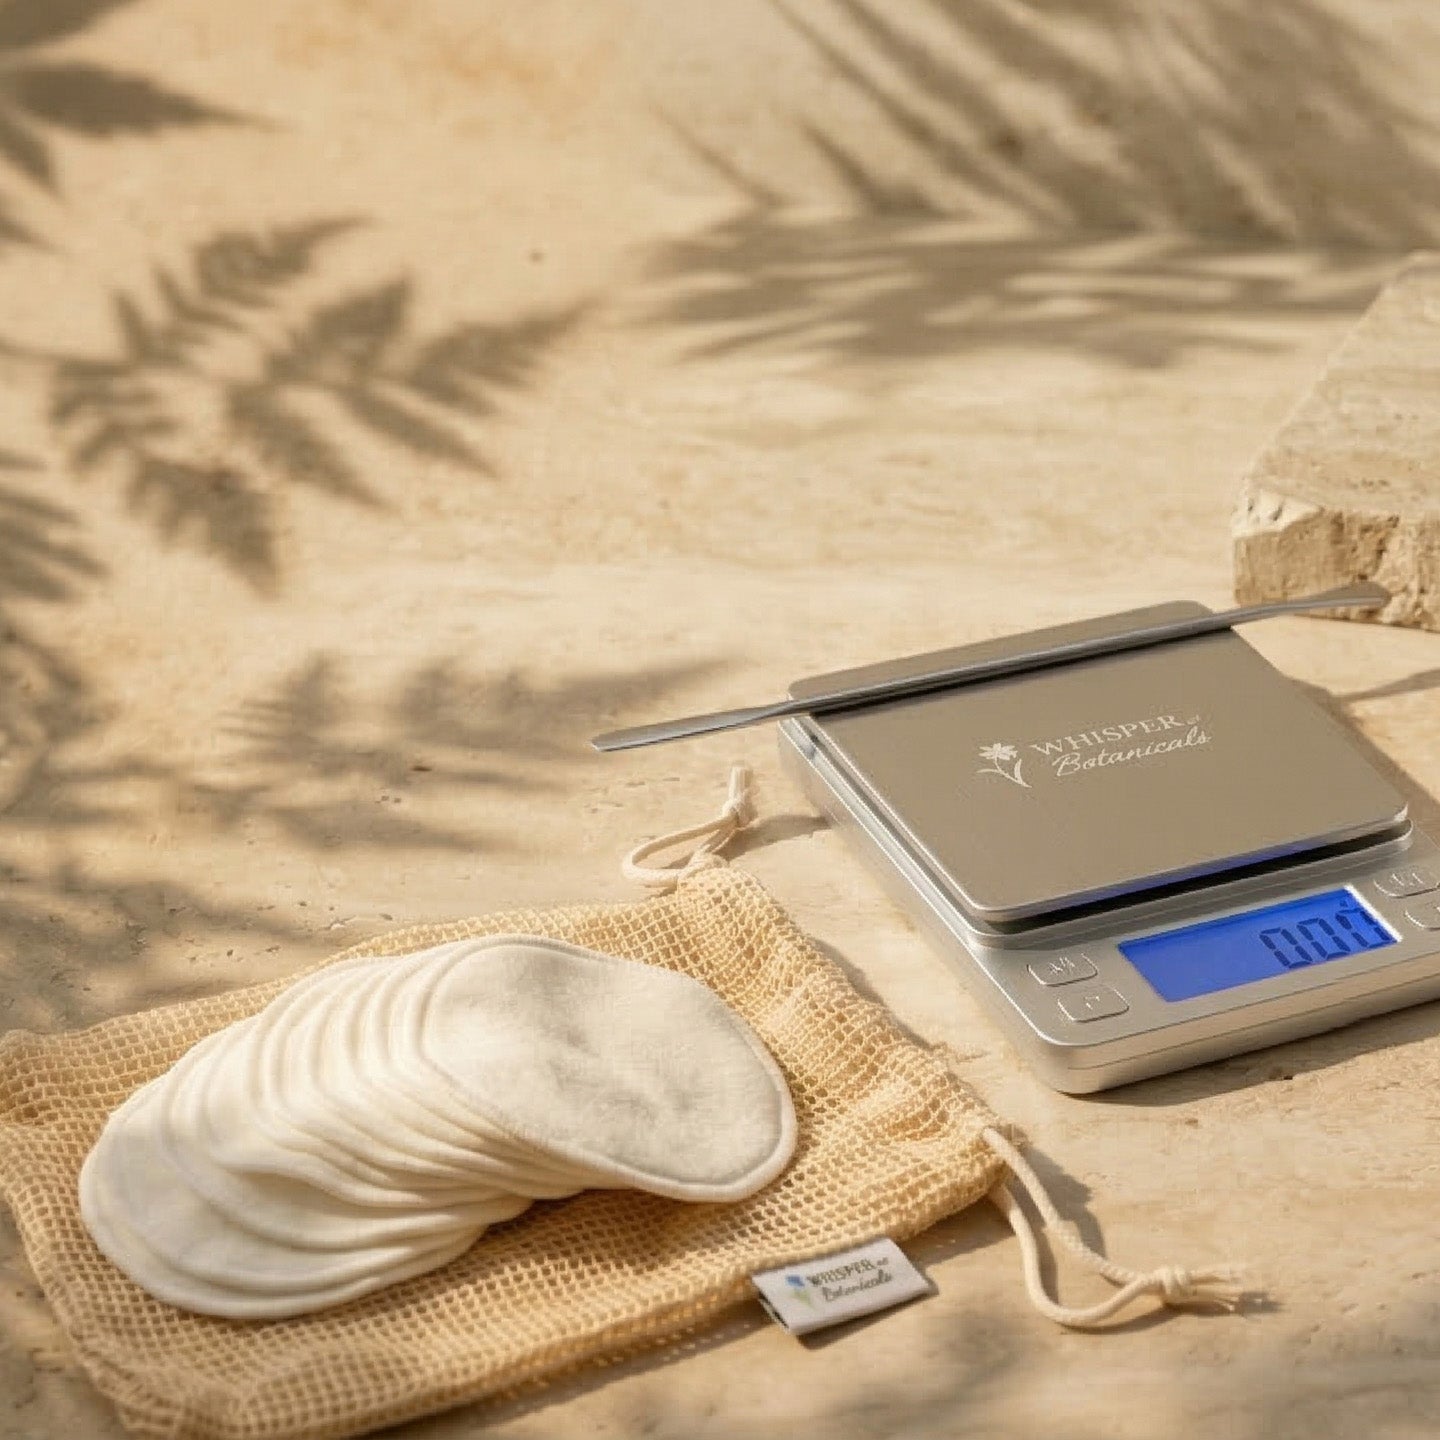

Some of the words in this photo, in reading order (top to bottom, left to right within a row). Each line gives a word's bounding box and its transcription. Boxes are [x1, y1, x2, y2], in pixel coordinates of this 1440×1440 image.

[1031, 714, 1184, 756] WHISPER
[1052, 726, 1212, 776] Botanicals
[806, 1258, 875, 1286] WHISPER
